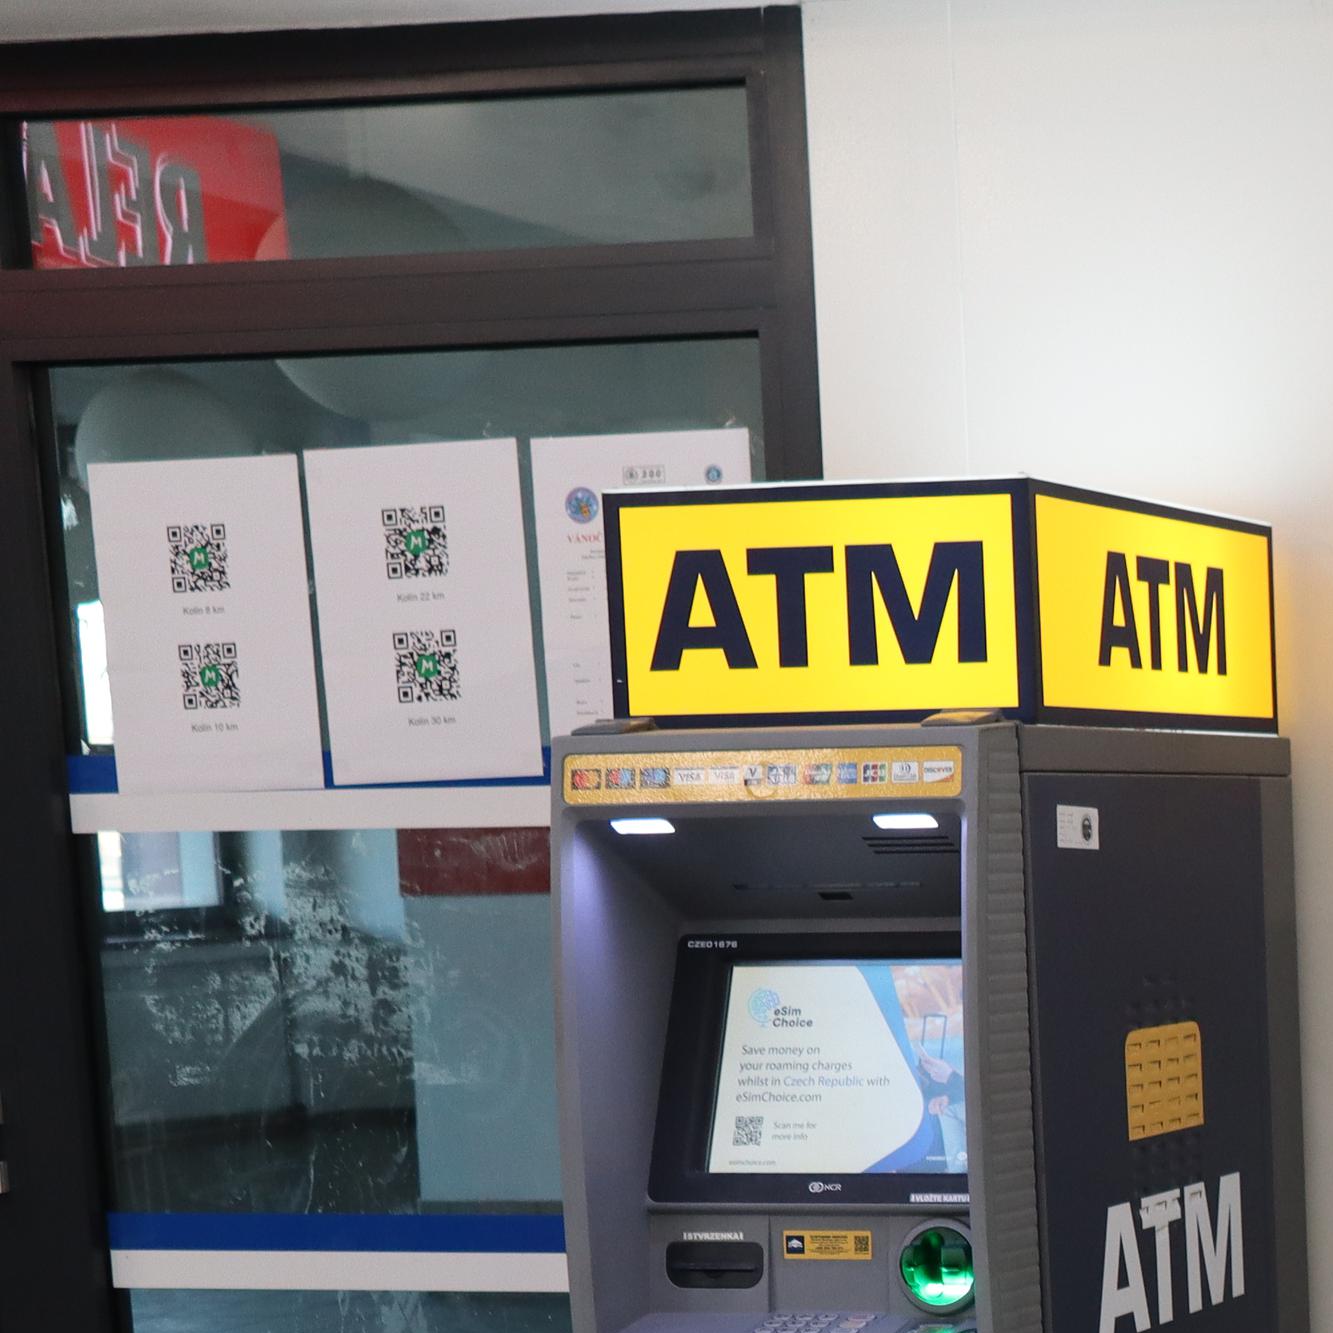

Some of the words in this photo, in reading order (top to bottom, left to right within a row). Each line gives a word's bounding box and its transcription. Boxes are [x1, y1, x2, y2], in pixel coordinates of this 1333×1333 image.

[432, 591, 445, 600] km
[212, 605, 225, 614] km
[649, 541, 988, 671] ATM
[1097, 550, 1228, 677] ATM
[442, 715, 456, 724] km
[224, 722, 239, 731] km
[773, 1006, 802, 1016] eSim
[772, 1017, 814, 1028] Choice
[742, 1045, 766, 1056] Save
[767, 1047, 805, 1058] money
[806, 1046, 821, 1055] on
[739, 1061, 763, 1073] your
[765, 1060, 810, 1073] roaming
[811, 1060, 853, 1072] charges
[737, 1076, 769, 1087] whilst
[771, 1076, 781, 1086] in
[783, 1076, 815, 1087] Czech
[817, 1076, 864, 1088] Republic
[866, 1076, 891, 1087] with
[735, 1092, 822, 1104] eSimChoice.com
[773, 1121, 791, 1130] Scan
[805, 1121, 817, 1130] for
[771, 1133, 791, 1141] more
[823, 1183, 842, 1192] NCR
